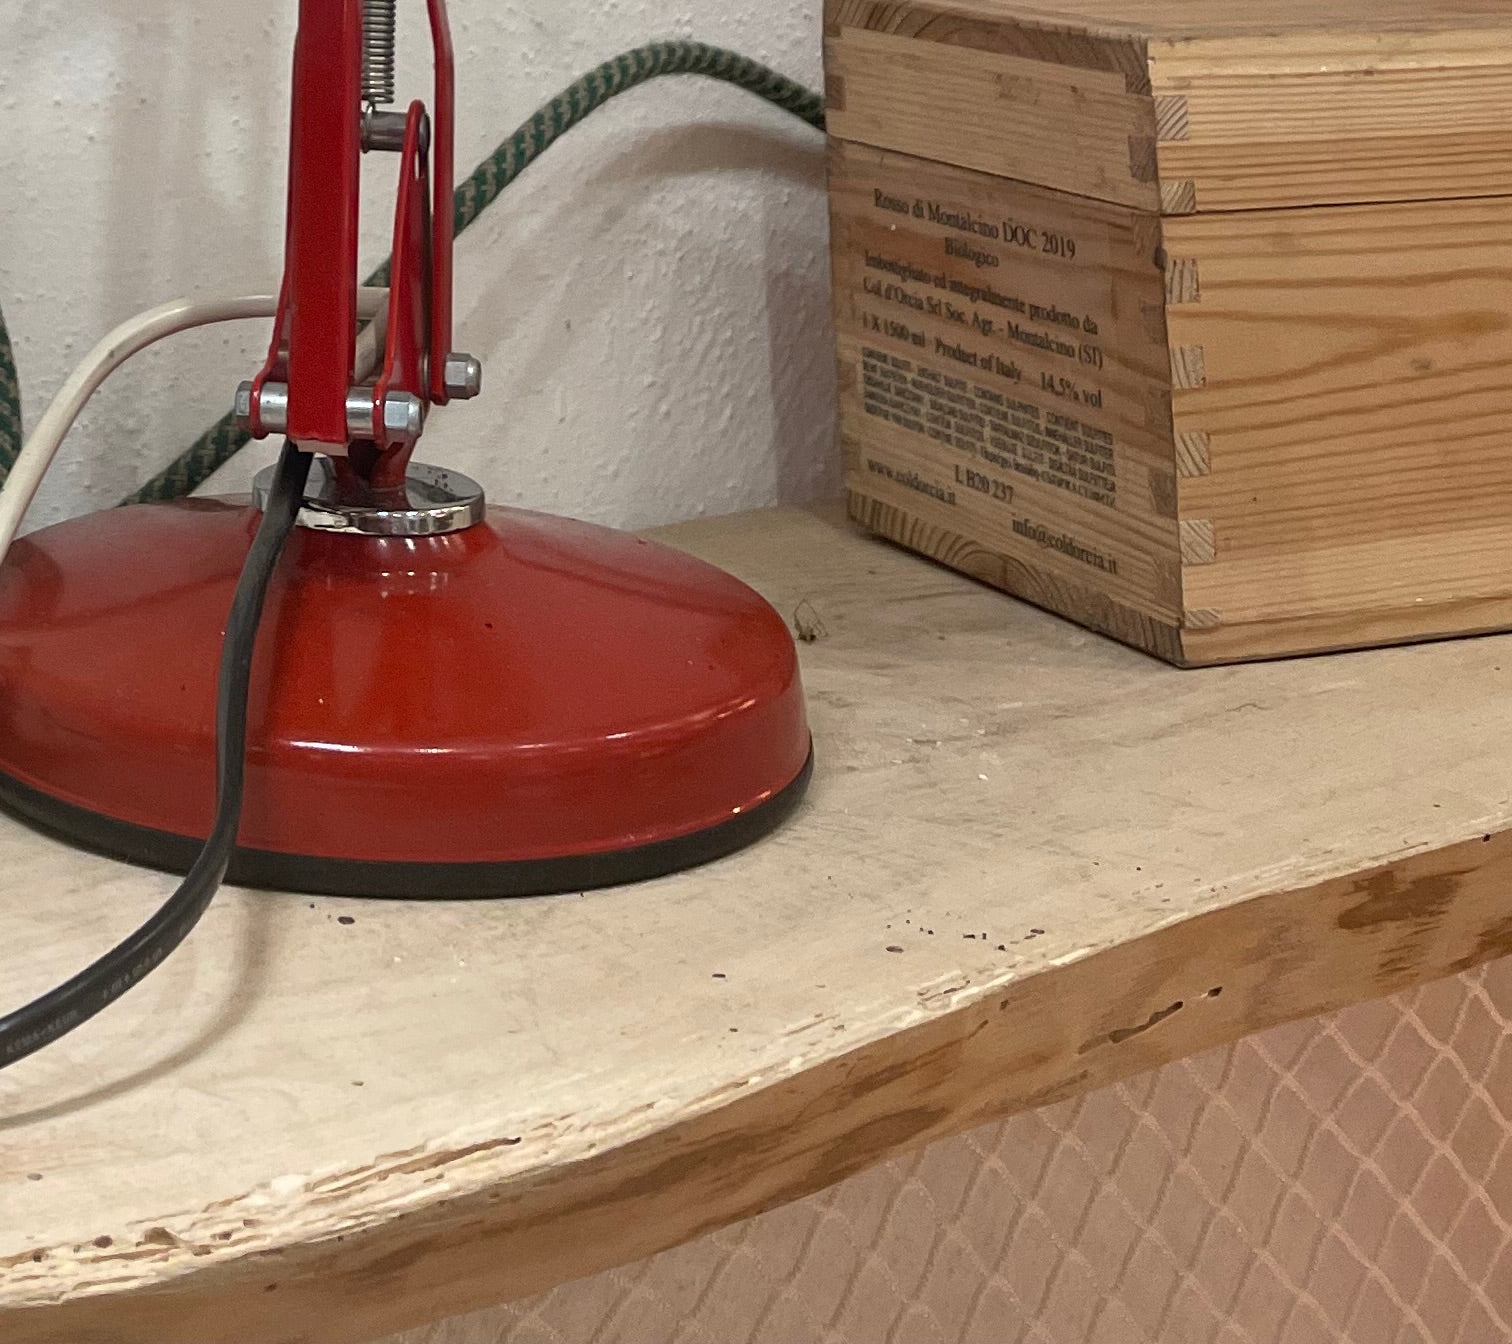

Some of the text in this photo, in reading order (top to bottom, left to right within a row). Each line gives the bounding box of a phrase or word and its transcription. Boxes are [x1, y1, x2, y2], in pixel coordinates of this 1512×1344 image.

[874, 188, 1076, 260] Rosso di Montalcino DOC 2019
[945, 237, 999, 268] Biologico
[863, 277, 882, 297] Col
[927, 296, 942, 316] Srl
[1007, 320, 1075, 358] Montalcino
[1078, 343, 1103, 371] (SI)
[949, 280, 1026, 313] integralmente
[1029, 304, 1080, 330] prodotto
[1082, 315, 1098, 335] da
[935, 337, 977, 367] Product
[980, 353, 995, 372] of
[995, 356, 1021, 385] Italy
[1041, 372, 1080, 401] 14.5%
[1083, 389, 1102, 409] vol
[955, 464, 964, 484] L
[992, 479, 1014, 505] 237
[1012, 512, 1117, 575] info@coldorcia.it
